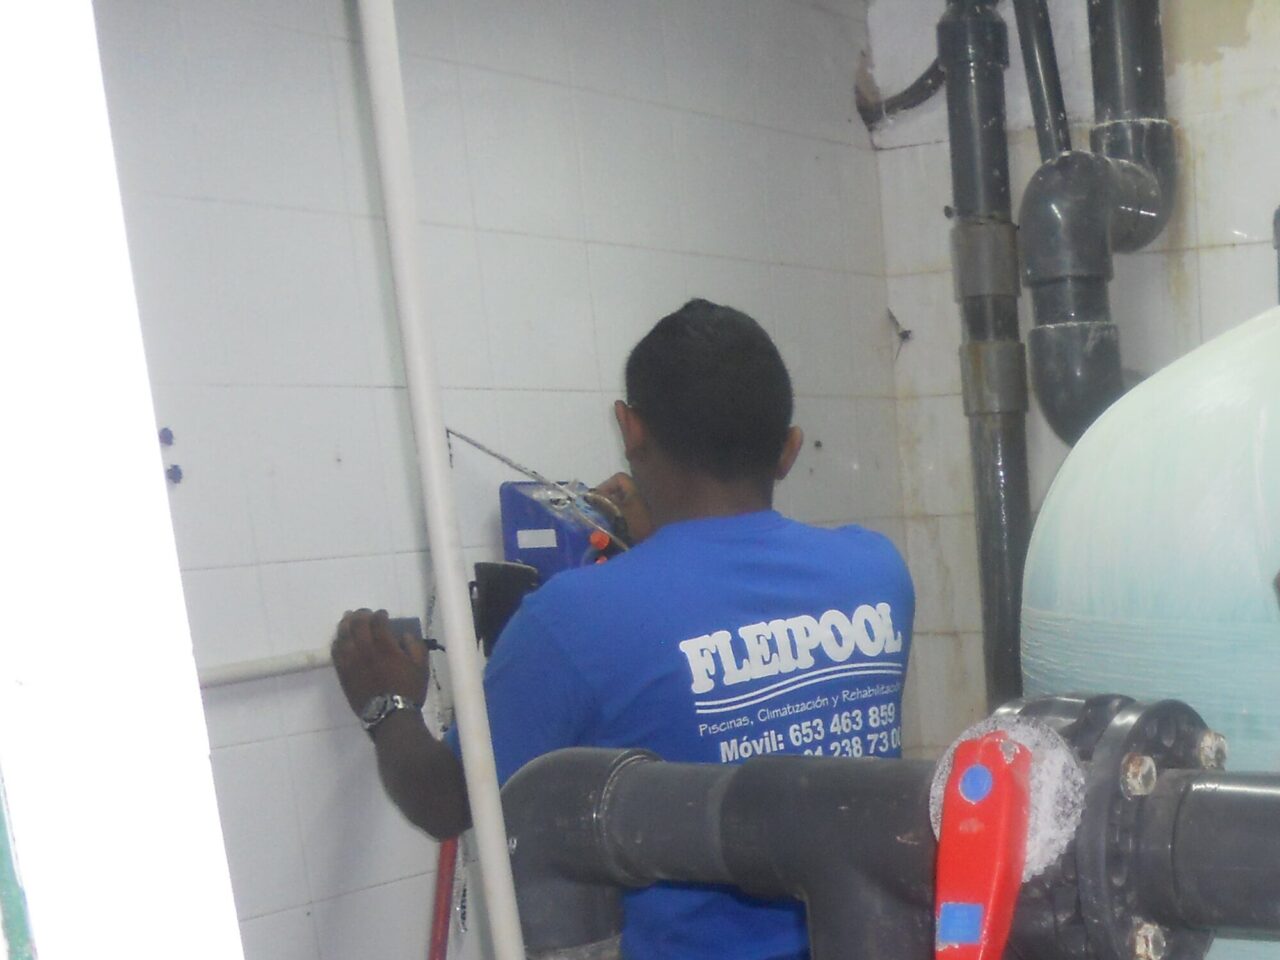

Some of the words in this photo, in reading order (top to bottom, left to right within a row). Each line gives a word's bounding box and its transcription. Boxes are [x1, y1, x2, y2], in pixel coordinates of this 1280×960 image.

[679, 602, 902, 694] FLEIPOOL
[699, 715, 754, 736] Piscinas,
[757, 696, 829, 723] Climatización
[831, 695, 839, 708] y
[720, 729, 784, 762] Móvil:
[789, 717, 825, 746] 653
[829, 709, 863, 735] 463
[868, 702, 896, 728] 859
[830, 735, 863, 757] 238
